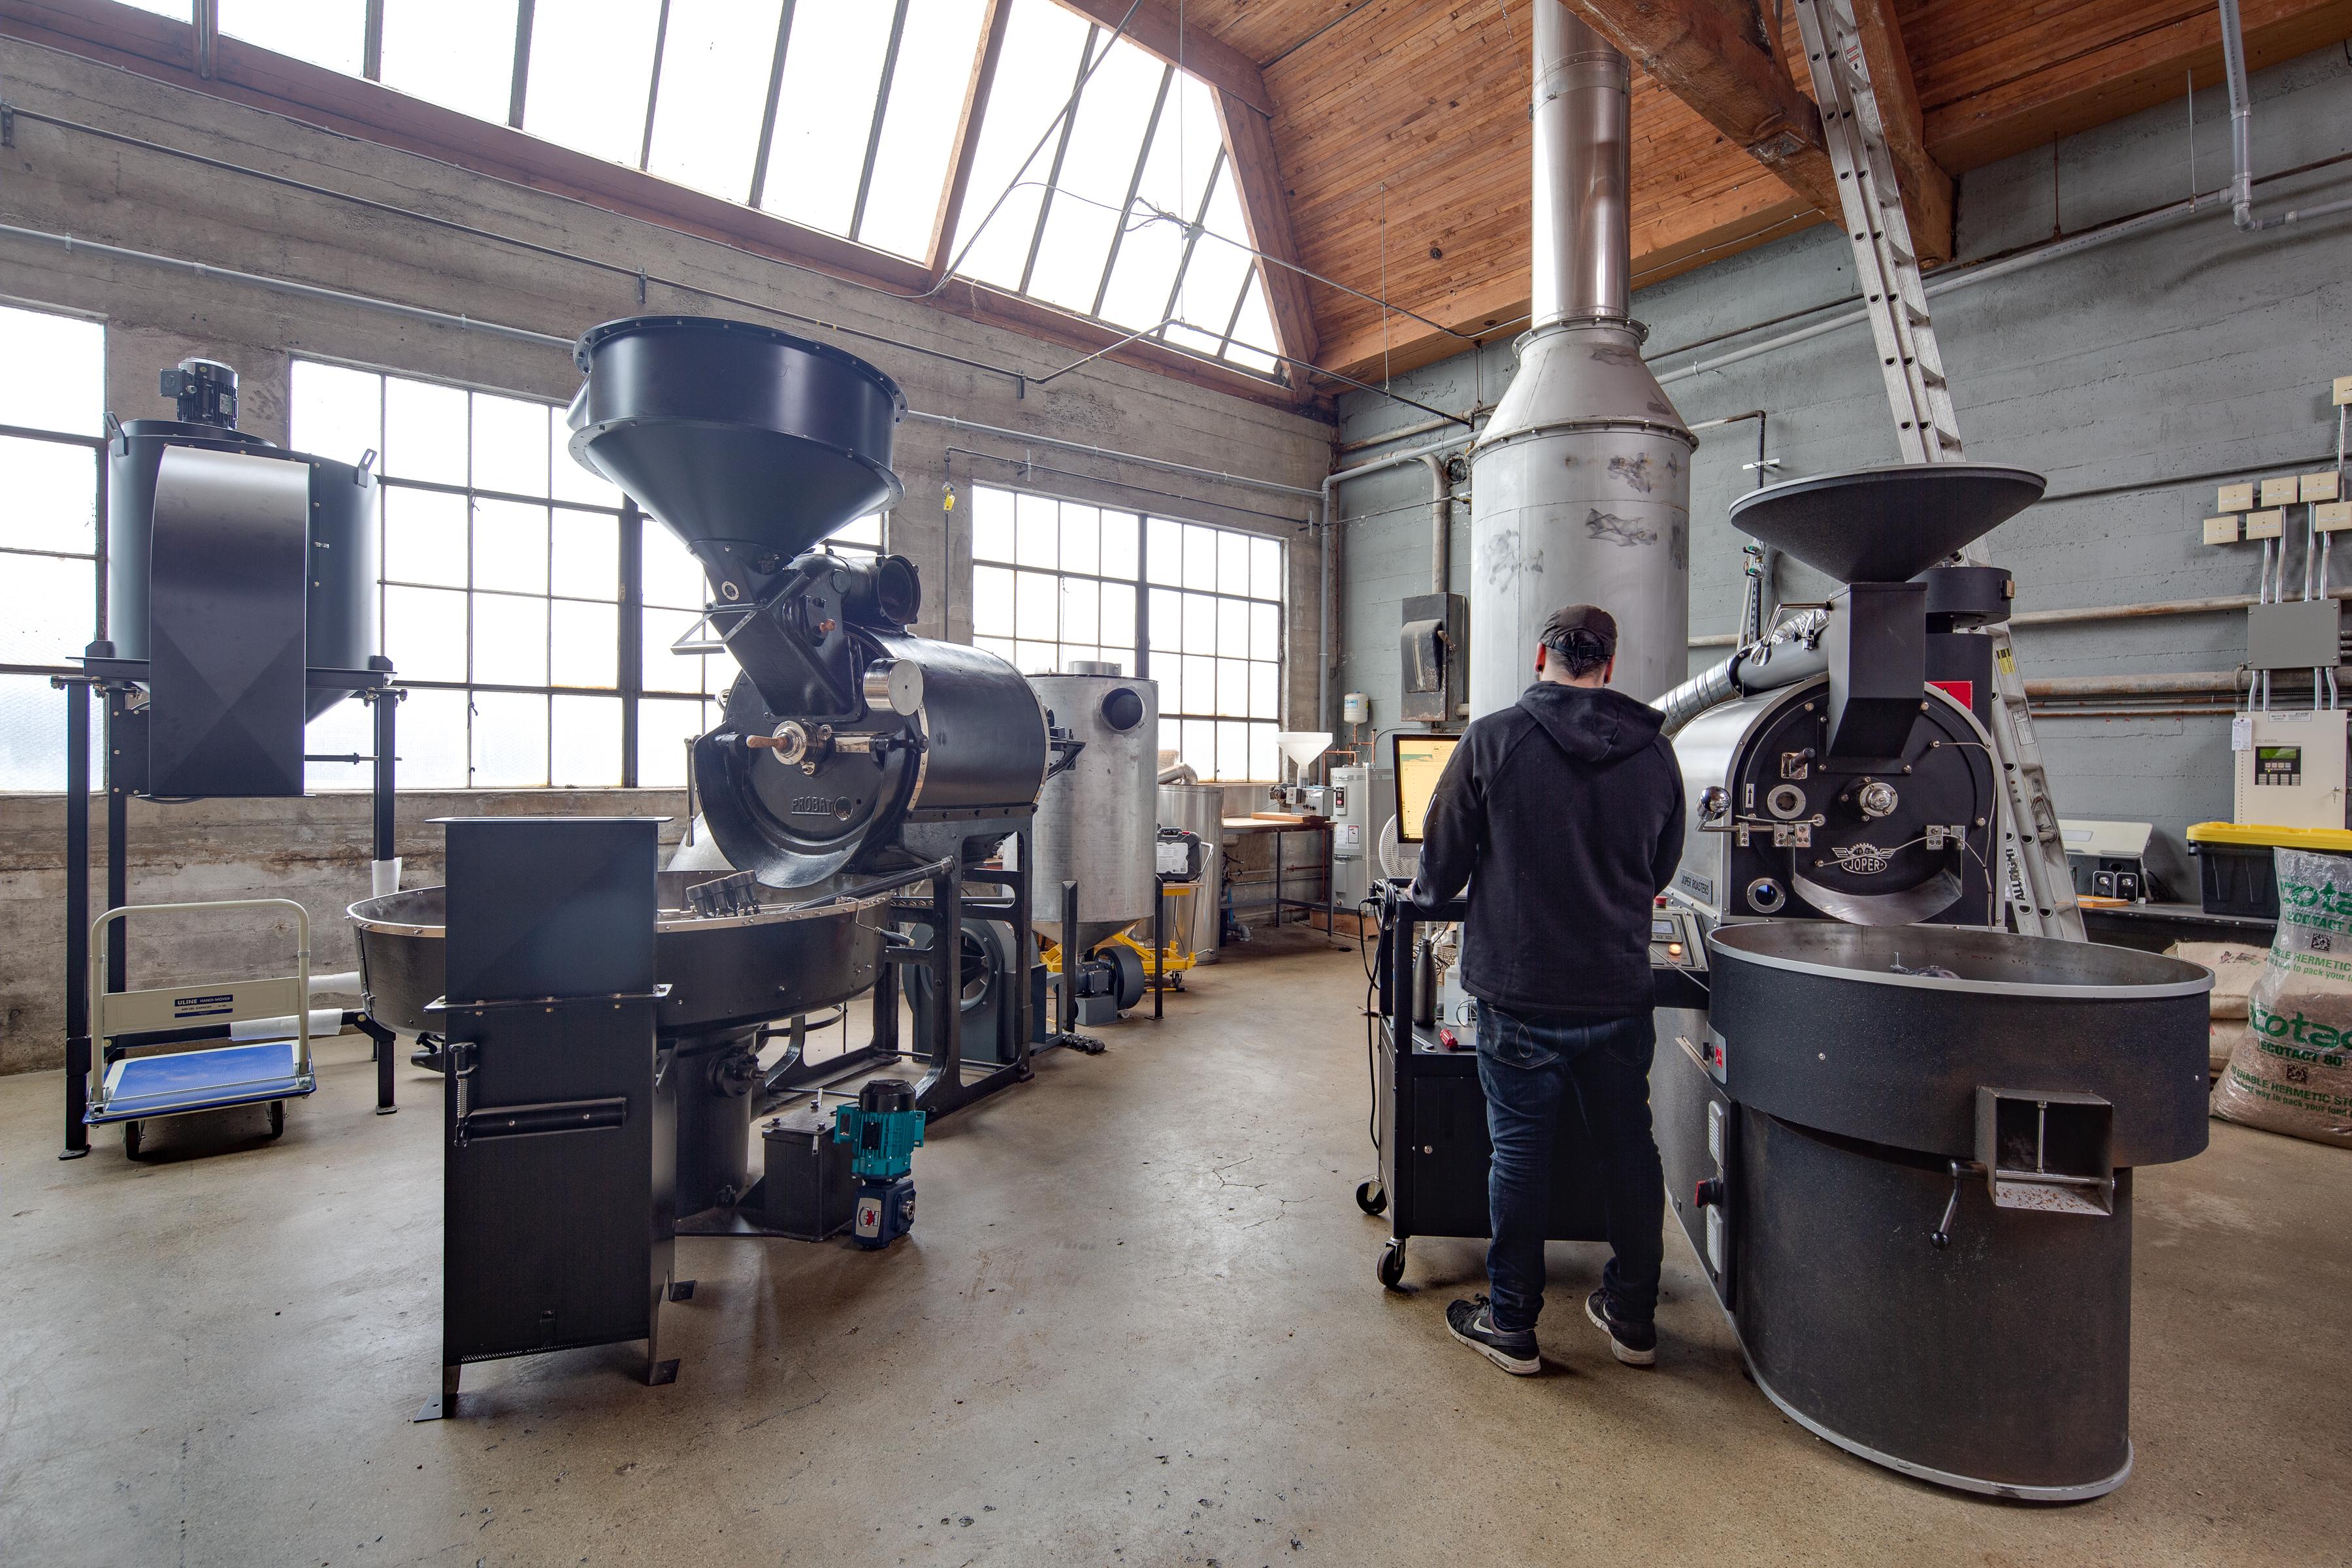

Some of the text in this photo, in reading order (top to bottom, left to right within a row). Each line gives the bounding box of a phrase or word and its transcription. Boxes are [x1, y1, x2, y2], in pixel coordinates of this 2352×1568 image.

[792, 796, 833, 813] PROBAT
[1849, 858, 1880, 872] JOPER
[1681, 875, 1709, 896] JOPER ROASTERS
[2287, 911, 2345, 932] ECOTACT
[2293, 964, 2301, 972] to
[2303, 968, 2323, 977] pack
[2326, 972, 2345, 981] your
[2294, 953, 2352, 972] HERMETIC
[2261, 1040, 2342, 1066] ECOTACT 80
[2237, 1070, 2268, 1088] ENABLE
[2272, 1083, 2330, 1103] HERMETIC
[2256, 1088, 2270, 1100] way
[2283, 1097, 2302, 1107] pack
[2306, 1102, 2325, 1112] your
[2328, 1105, 2347, 1117] food
